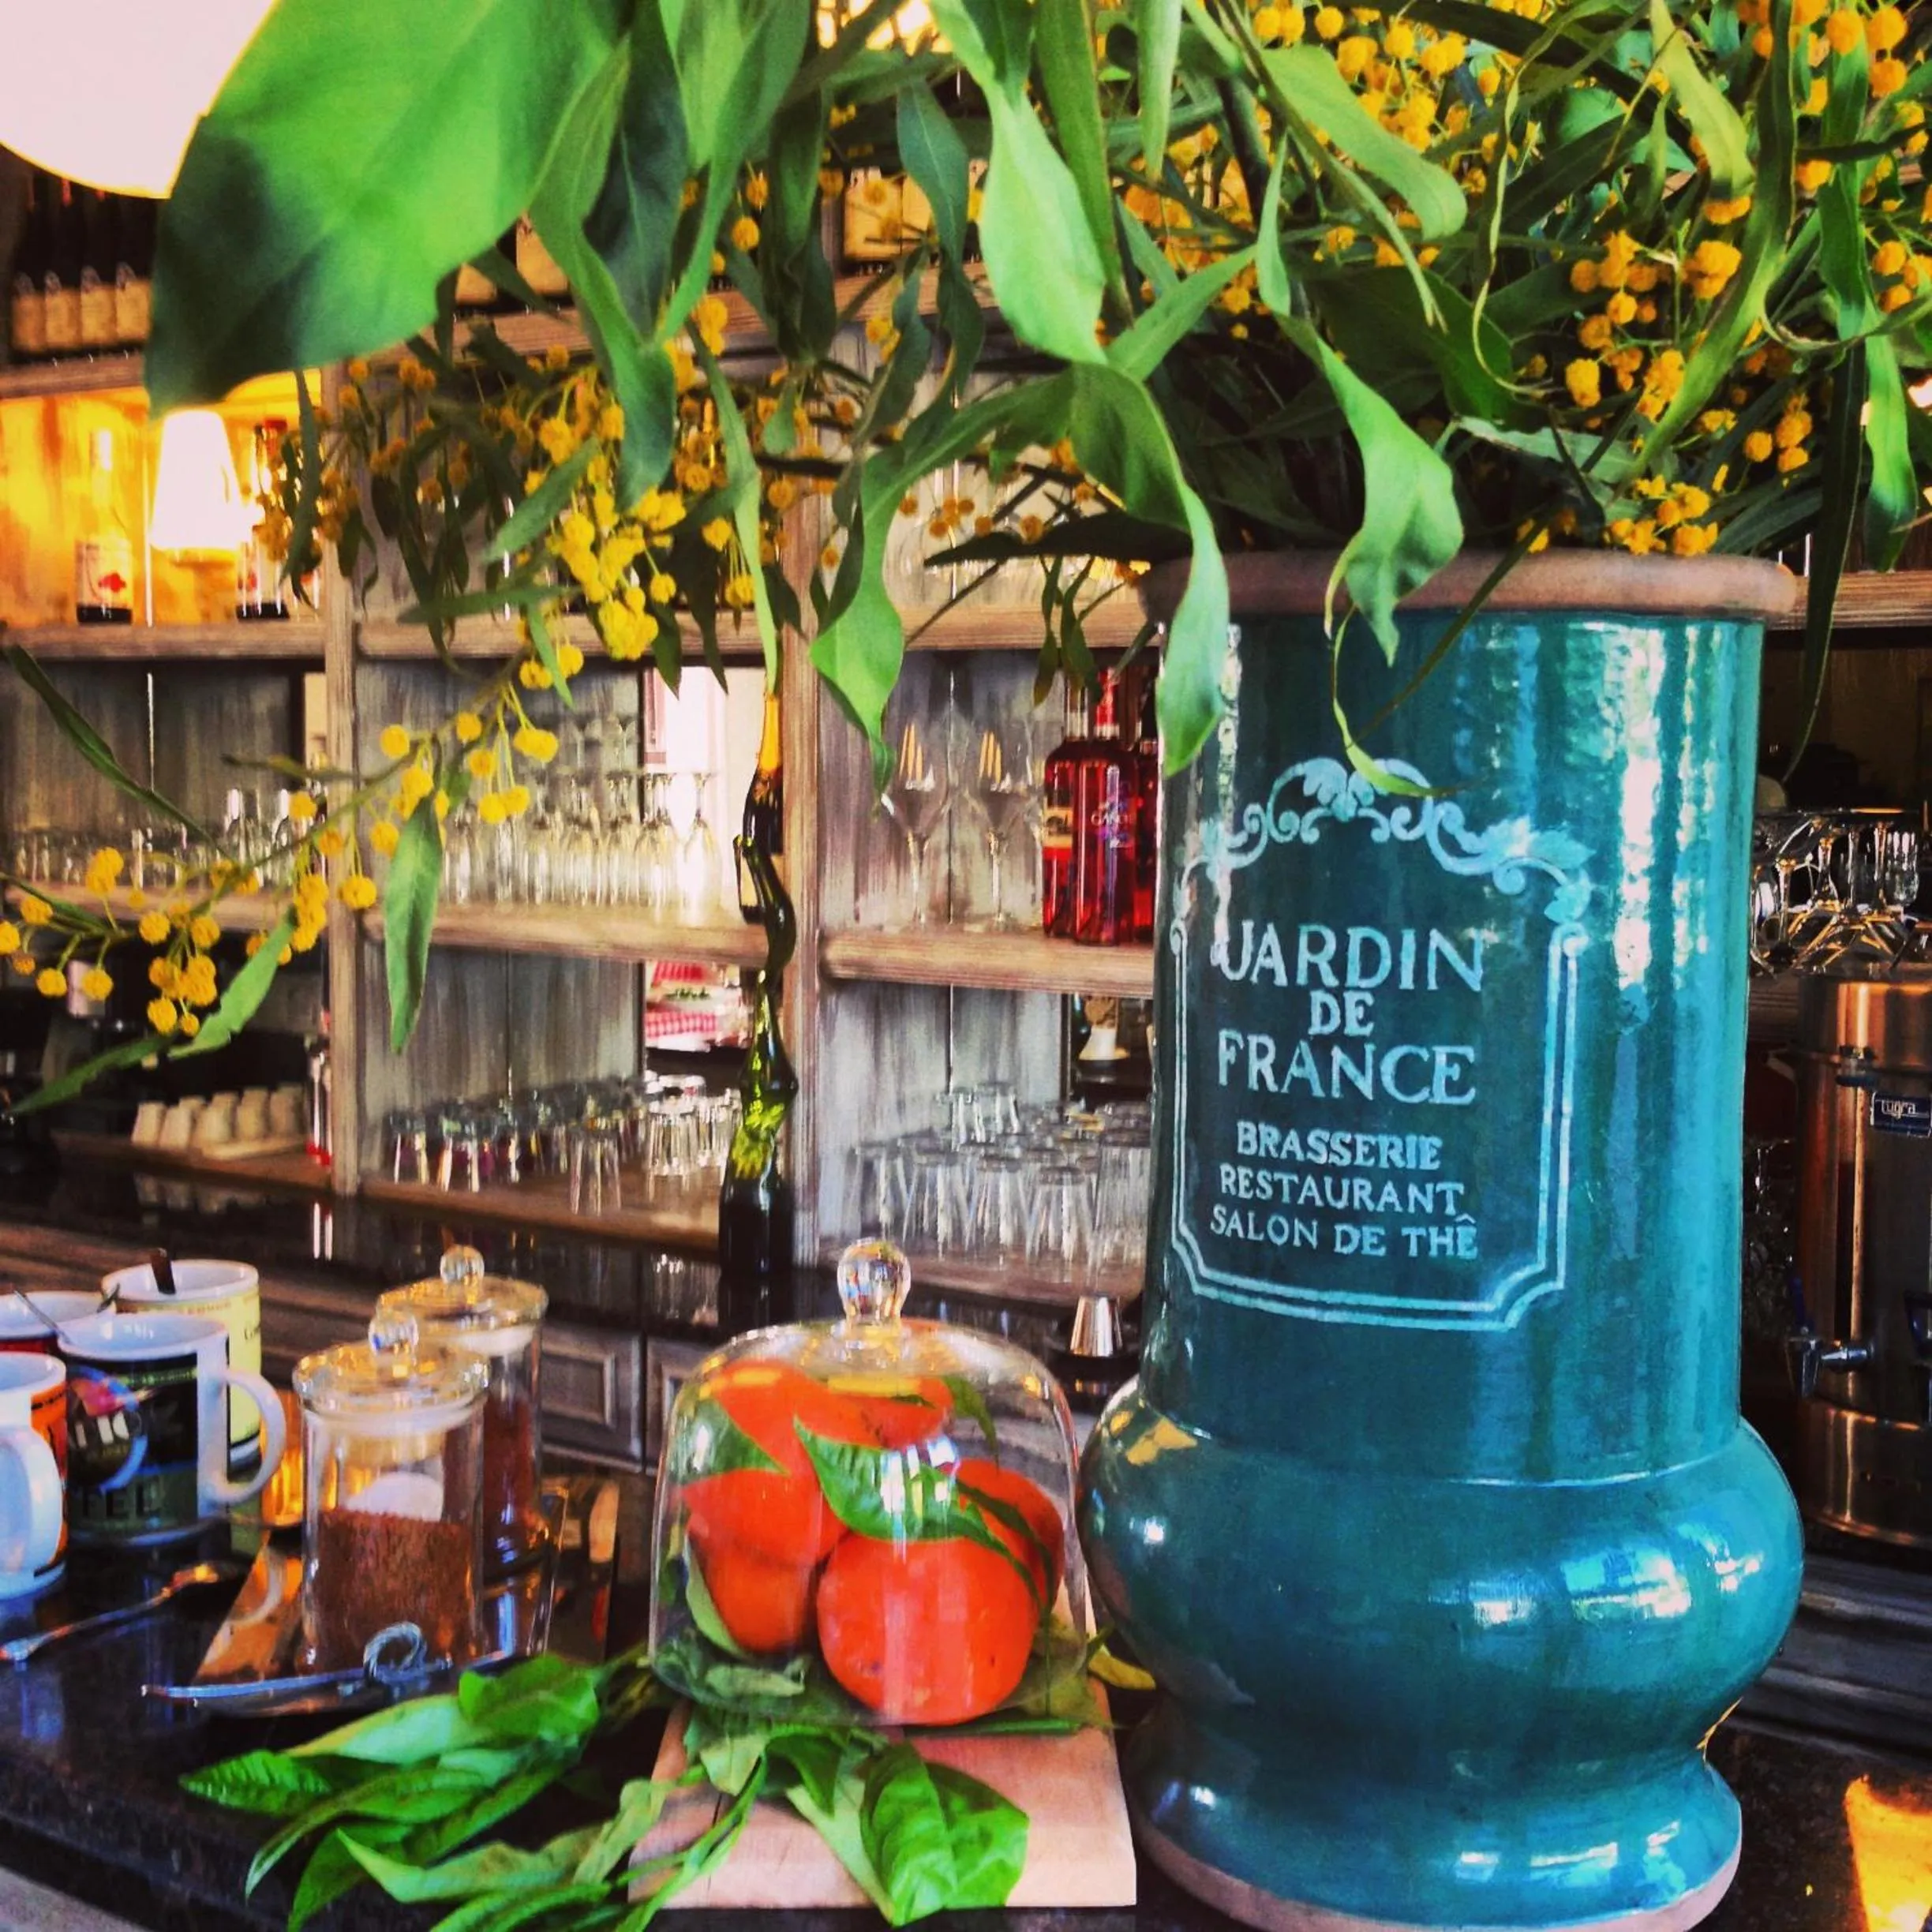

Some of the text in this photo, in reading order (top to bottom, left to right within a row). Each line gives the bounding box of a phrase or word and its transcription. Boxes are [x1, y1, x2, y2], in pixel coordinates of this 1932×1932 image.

[1211, 918, 1485, 992] JARDIN
[1308, 989, 1376, 1037] DE
[1218, 1028, 1477, 1105] FRANCE
[1237, 1119, 1443, 1170] BRASSERIE
[1219, 1163, 1466, 1216] RESTAURANT
[1210, 1204, 1319, 1250] SALON
[1334, 1224, 1387, 1256] DE
